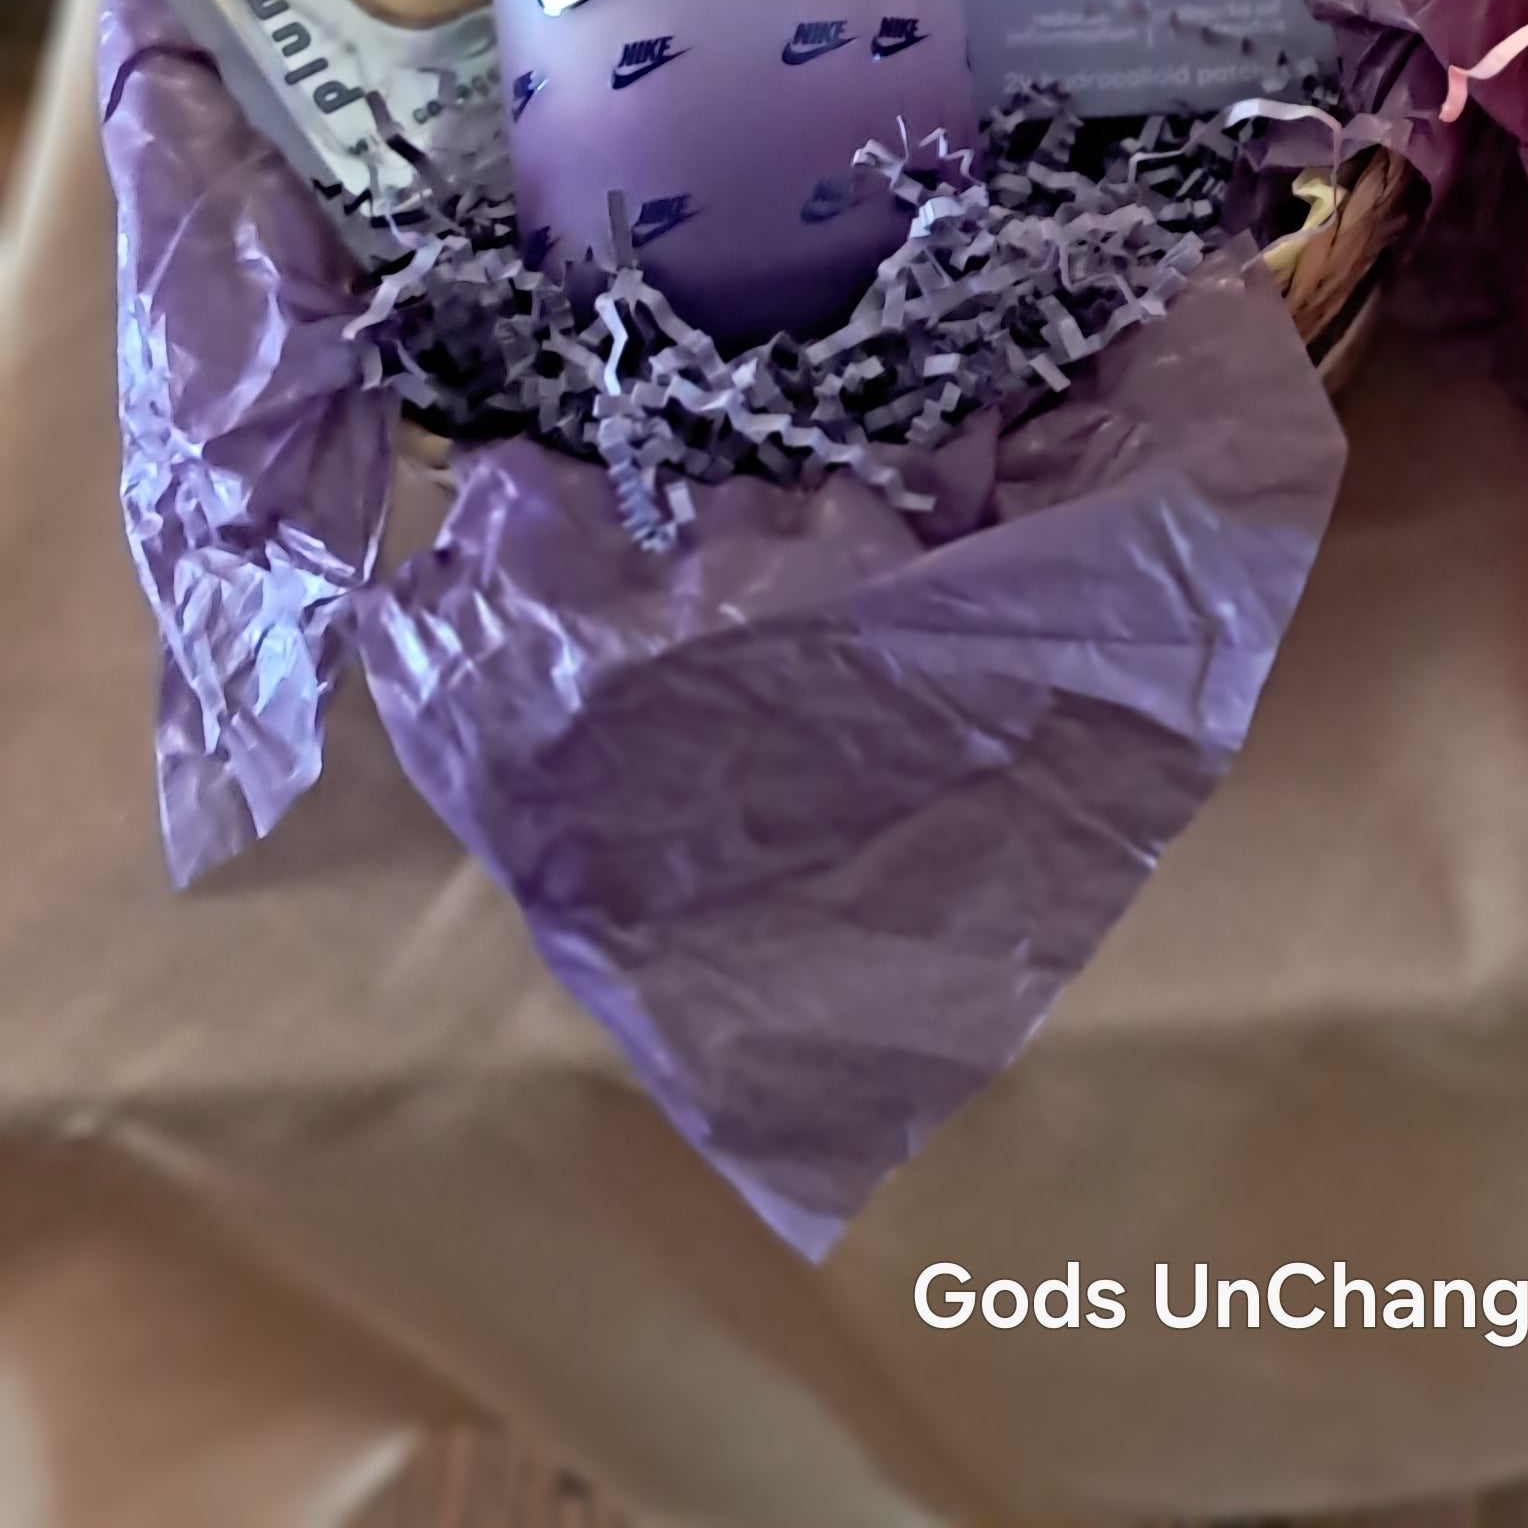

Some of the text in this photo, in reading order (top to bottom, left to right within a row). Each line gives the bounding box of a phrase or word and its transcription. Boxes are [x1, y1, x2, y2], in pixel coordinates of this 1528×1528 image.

[794, 19, 849, 45] NIKE
[878, 17, 921, 39] NIKE
[618, 36, 675, 68] NIKE
